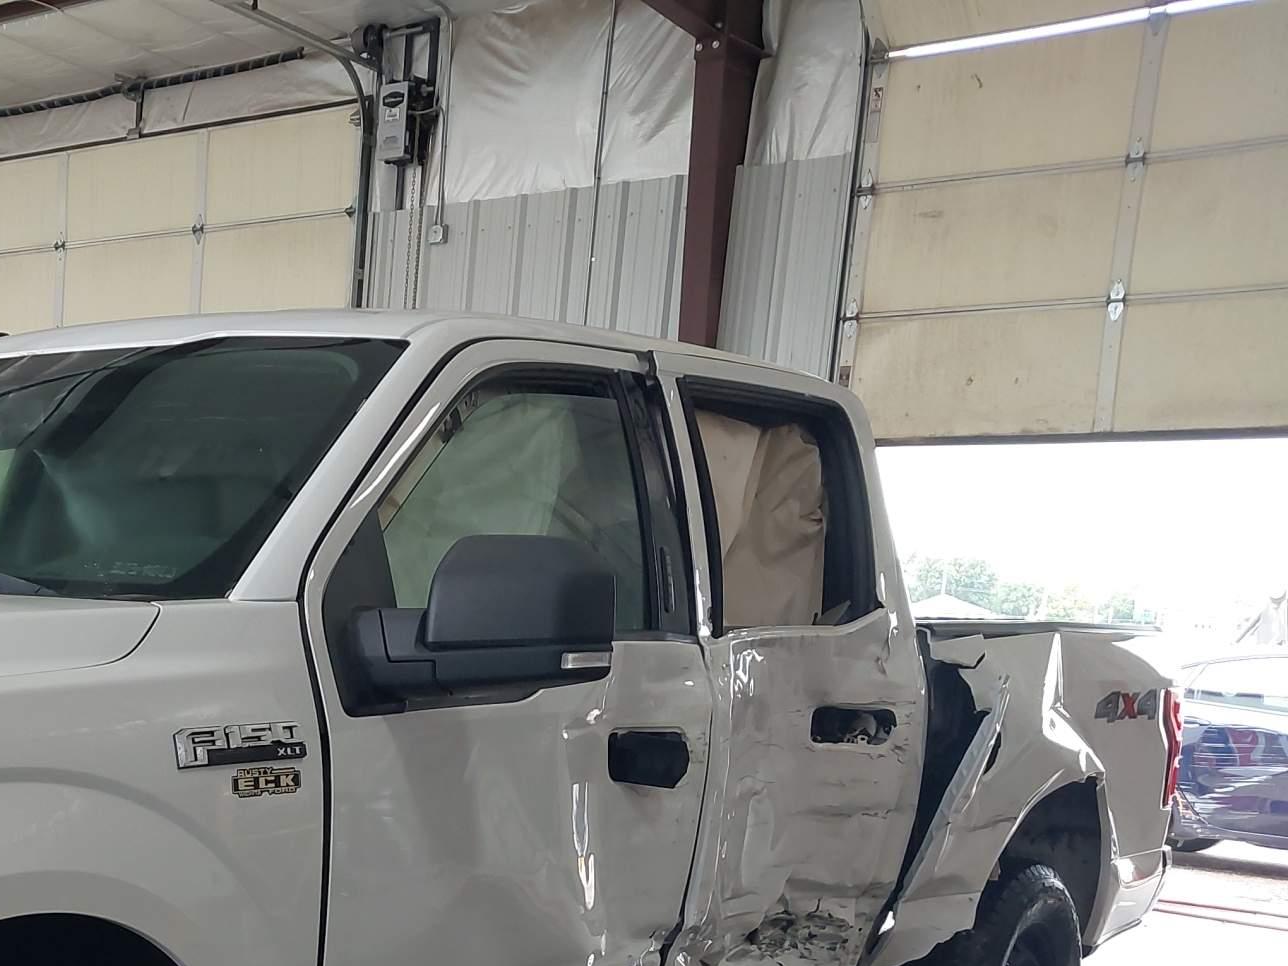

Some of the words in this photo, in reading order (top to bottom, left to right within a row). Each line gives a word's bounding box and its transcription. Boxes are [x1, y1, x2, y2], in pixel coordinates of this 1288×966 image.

[276, 746, 302, 757] XLT
[237, 767, 273, 778] RUSTY
[237, 774, 296, 791] ECK
[268, 786, 296, 795] FORD
